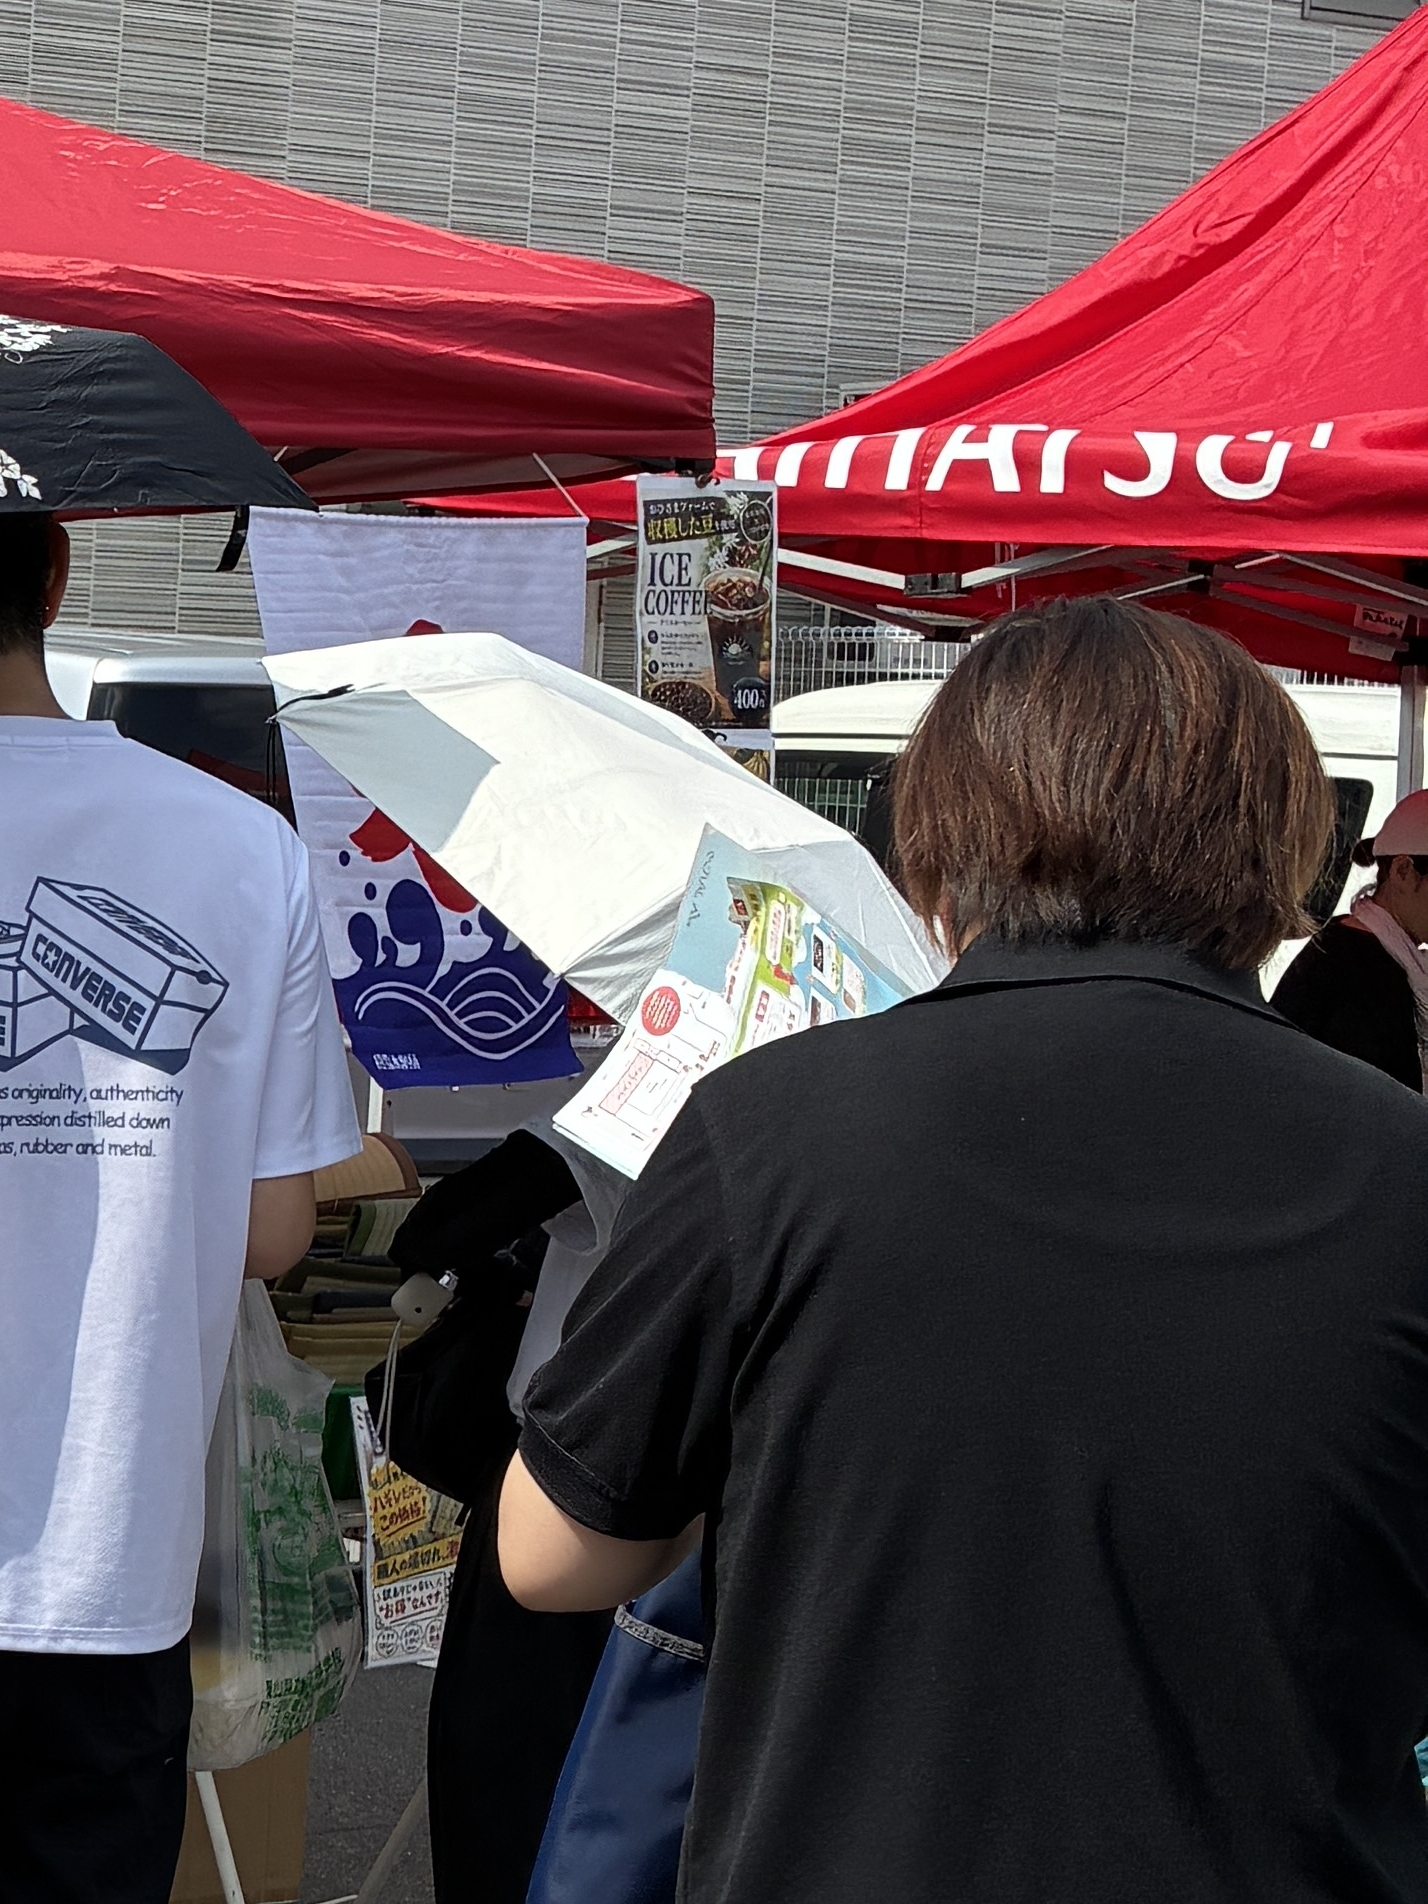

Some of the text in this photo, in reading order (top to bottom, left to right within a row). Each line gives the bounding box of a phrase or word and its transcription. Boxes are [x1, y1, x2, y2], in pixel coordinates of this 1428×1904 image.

[647, 552, 692, 587] ICE
[31, 932, 147, 1035] CONVERSE
[11, 1082, 87, 1103] originality,
[89, 1084, 183, 1106] authenticity
[63, 1111, 125, 1129] distilled
[128, 1115, 170, 1130] down
[20, 1139, 72, 1155] rubber
[75, 1140, 105, 1156] and
[108, 1140, 156, 1157] metal.
